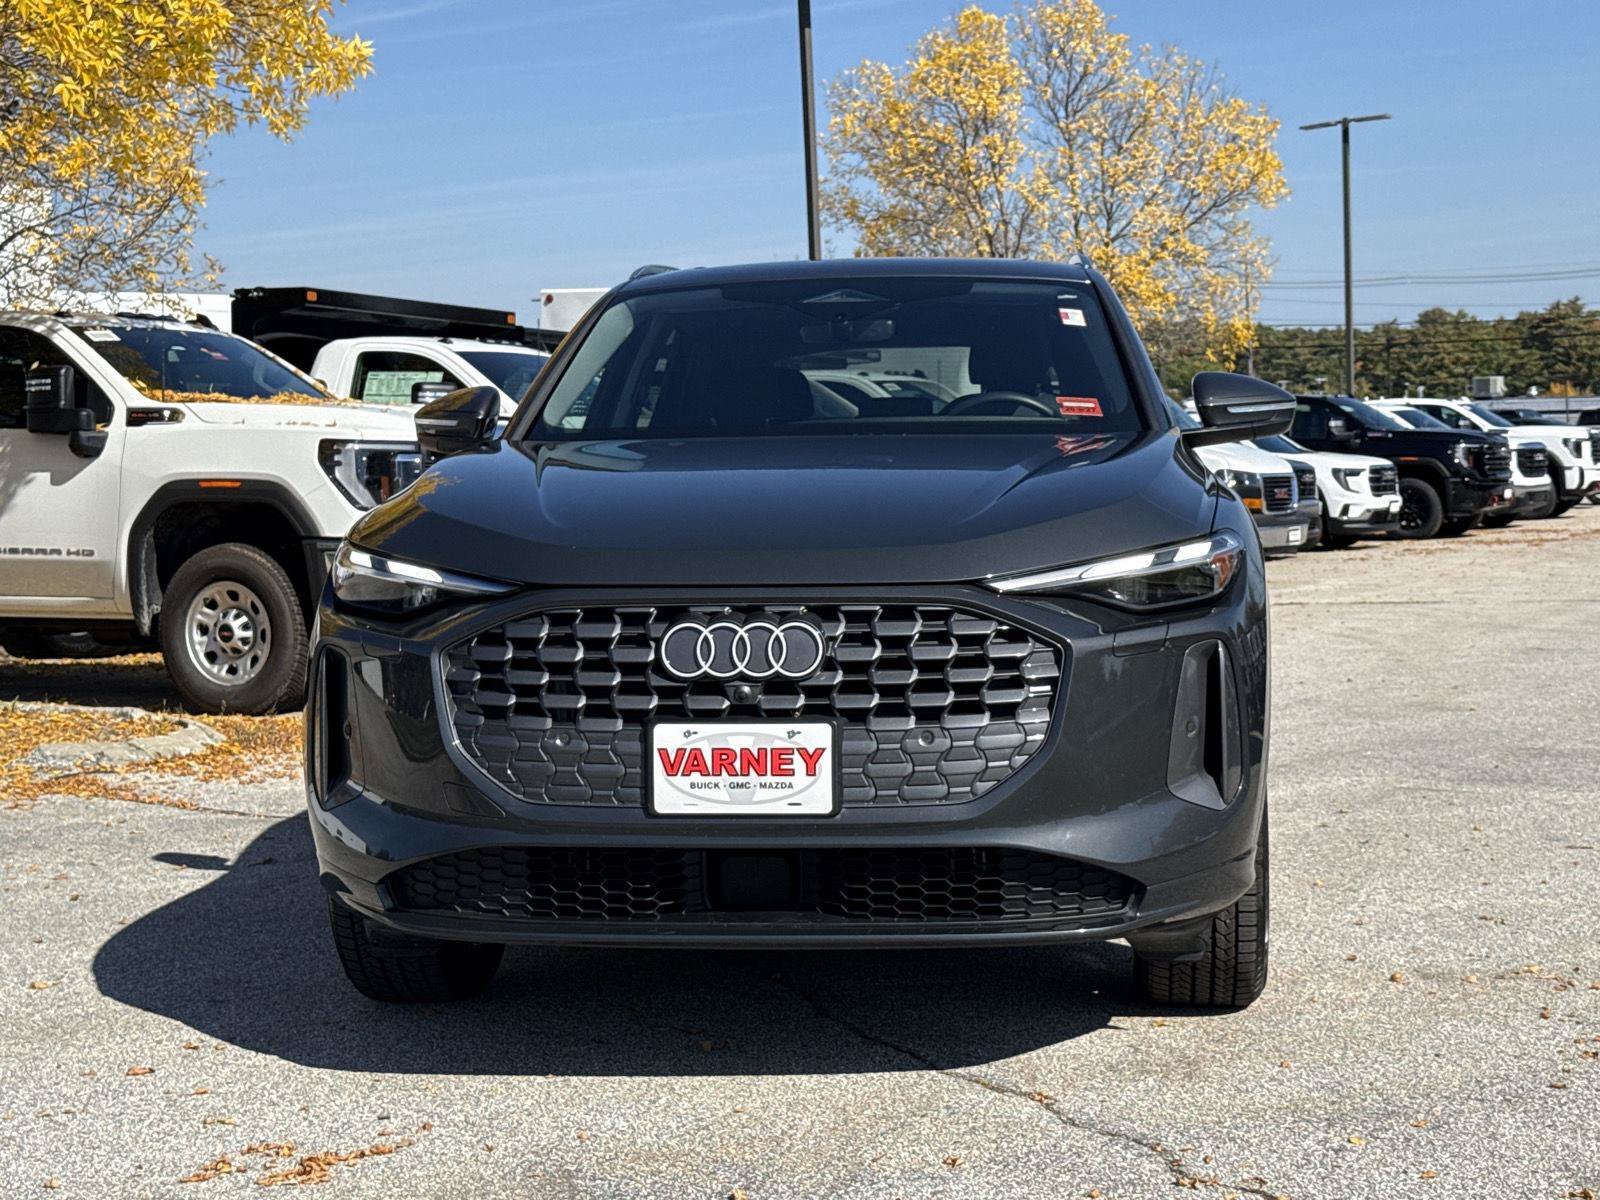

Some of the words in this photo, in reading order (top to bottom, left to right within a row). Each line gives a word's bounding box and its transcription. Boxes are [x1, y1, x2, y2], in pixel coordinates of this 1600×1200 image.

[0, 547, 62, 556] IERRA
[657, 747, 827, 777] VARNEY
[689, 781, 721, 790] BUICK
[728, 781, 752, 790] GMC
[759, 781, 794, 790] MAZDA
